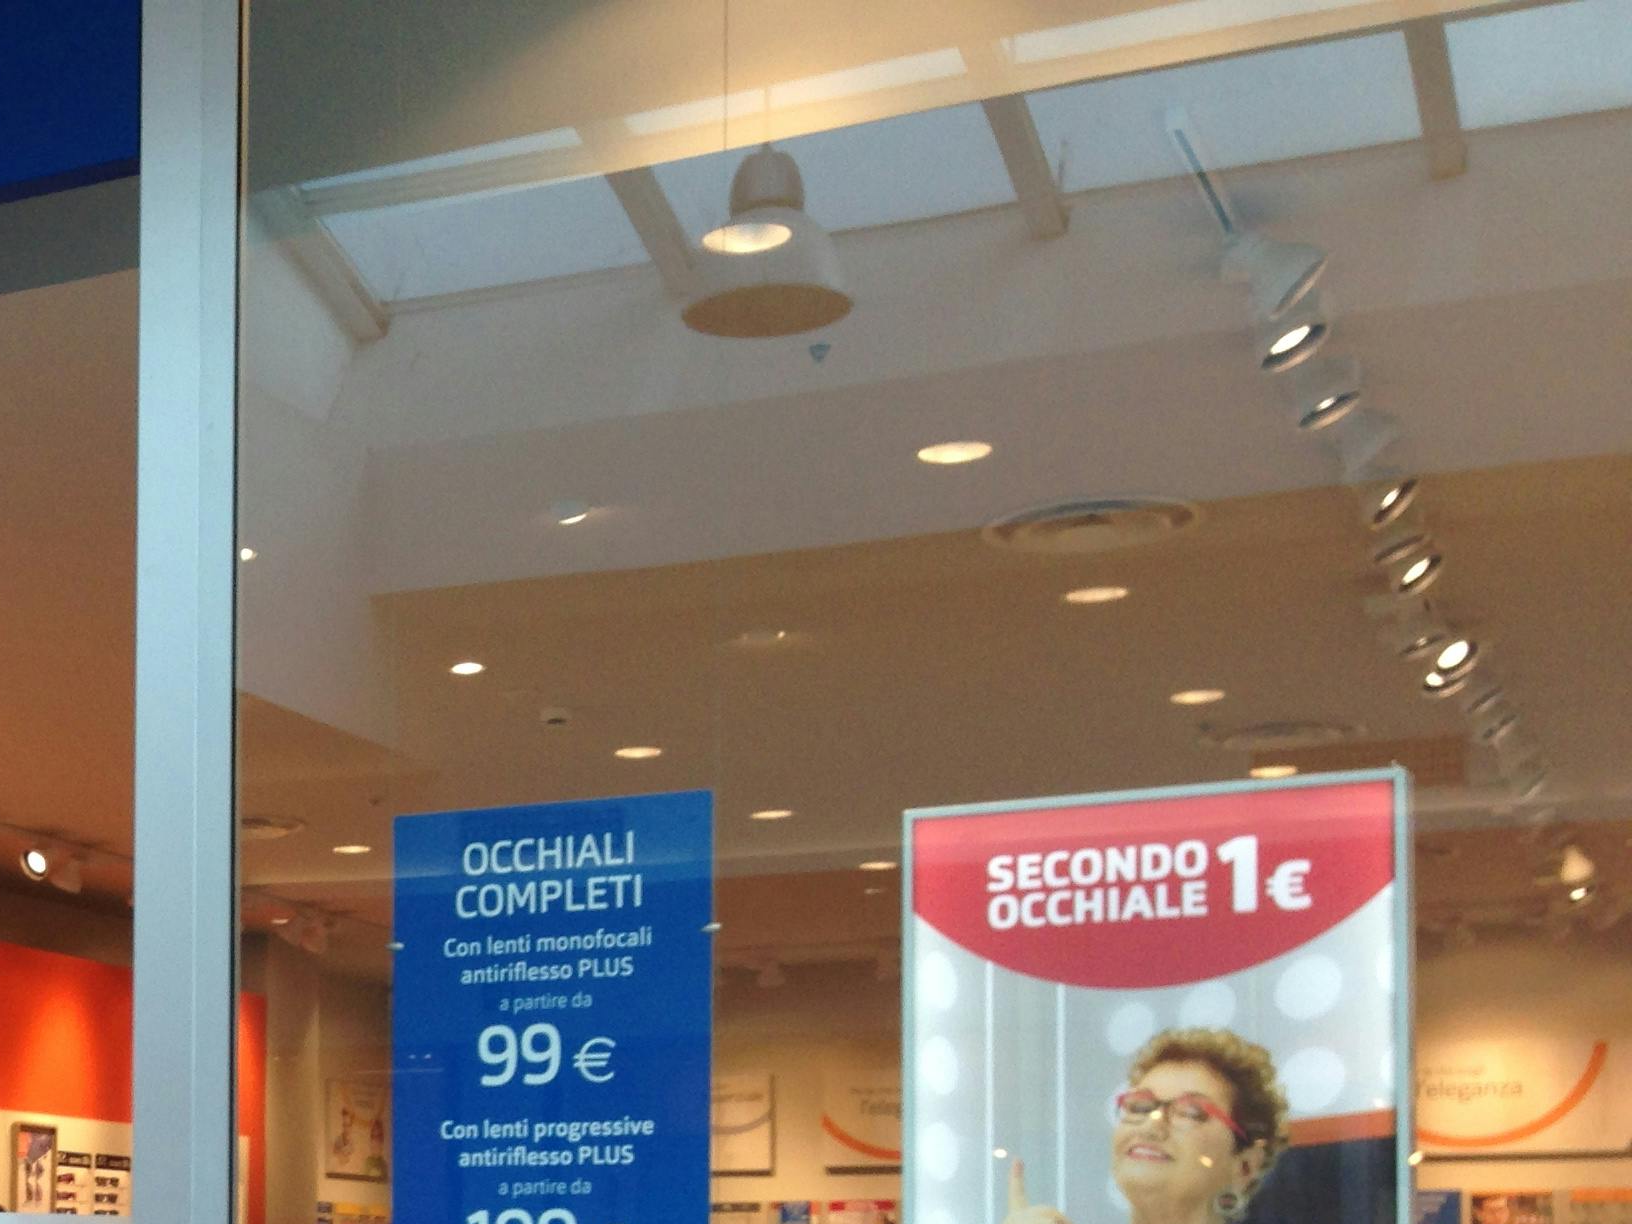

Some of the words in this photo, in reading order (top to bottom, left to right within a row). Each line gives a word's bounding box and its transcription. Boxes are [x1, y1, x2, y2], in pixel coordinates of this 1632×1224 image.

[461, 830, 636, 876] OCCHIALI
[986, 840, 1208, 892] SECONDO
[455, 874, 643, 919] COMPLETI
[986, 880, 1208, 930] OCCHIALE
[443, 938, 481, 957] Con
[486, 934, 531, 955] lenti
[536, 926, 653, 952] monofocali
[460, 960, 573, 985] antiriflesso
[578, 956, 635, 979] PLUS
[499, 997, 510, 1011] a
[513, 992, 568, 1014] partire
[571, 992, 593, 1009] da
[477, 1022, 562, 1087] 99
[573, 1036, 617, 1083] €
[440, 1120, 479, 1140] Con
[483, 1118, 529, 1139] lenti
[533, 1116, 656, 1143] progressive
[458, 1145, 573, 1167] antiriflesso
[578, 1144, 635, 1165] PLUS
[498, 1181, 509, 1195] a
[511, 1178, 567, 1199] partire
[570, 1177, 593, 1194] da
